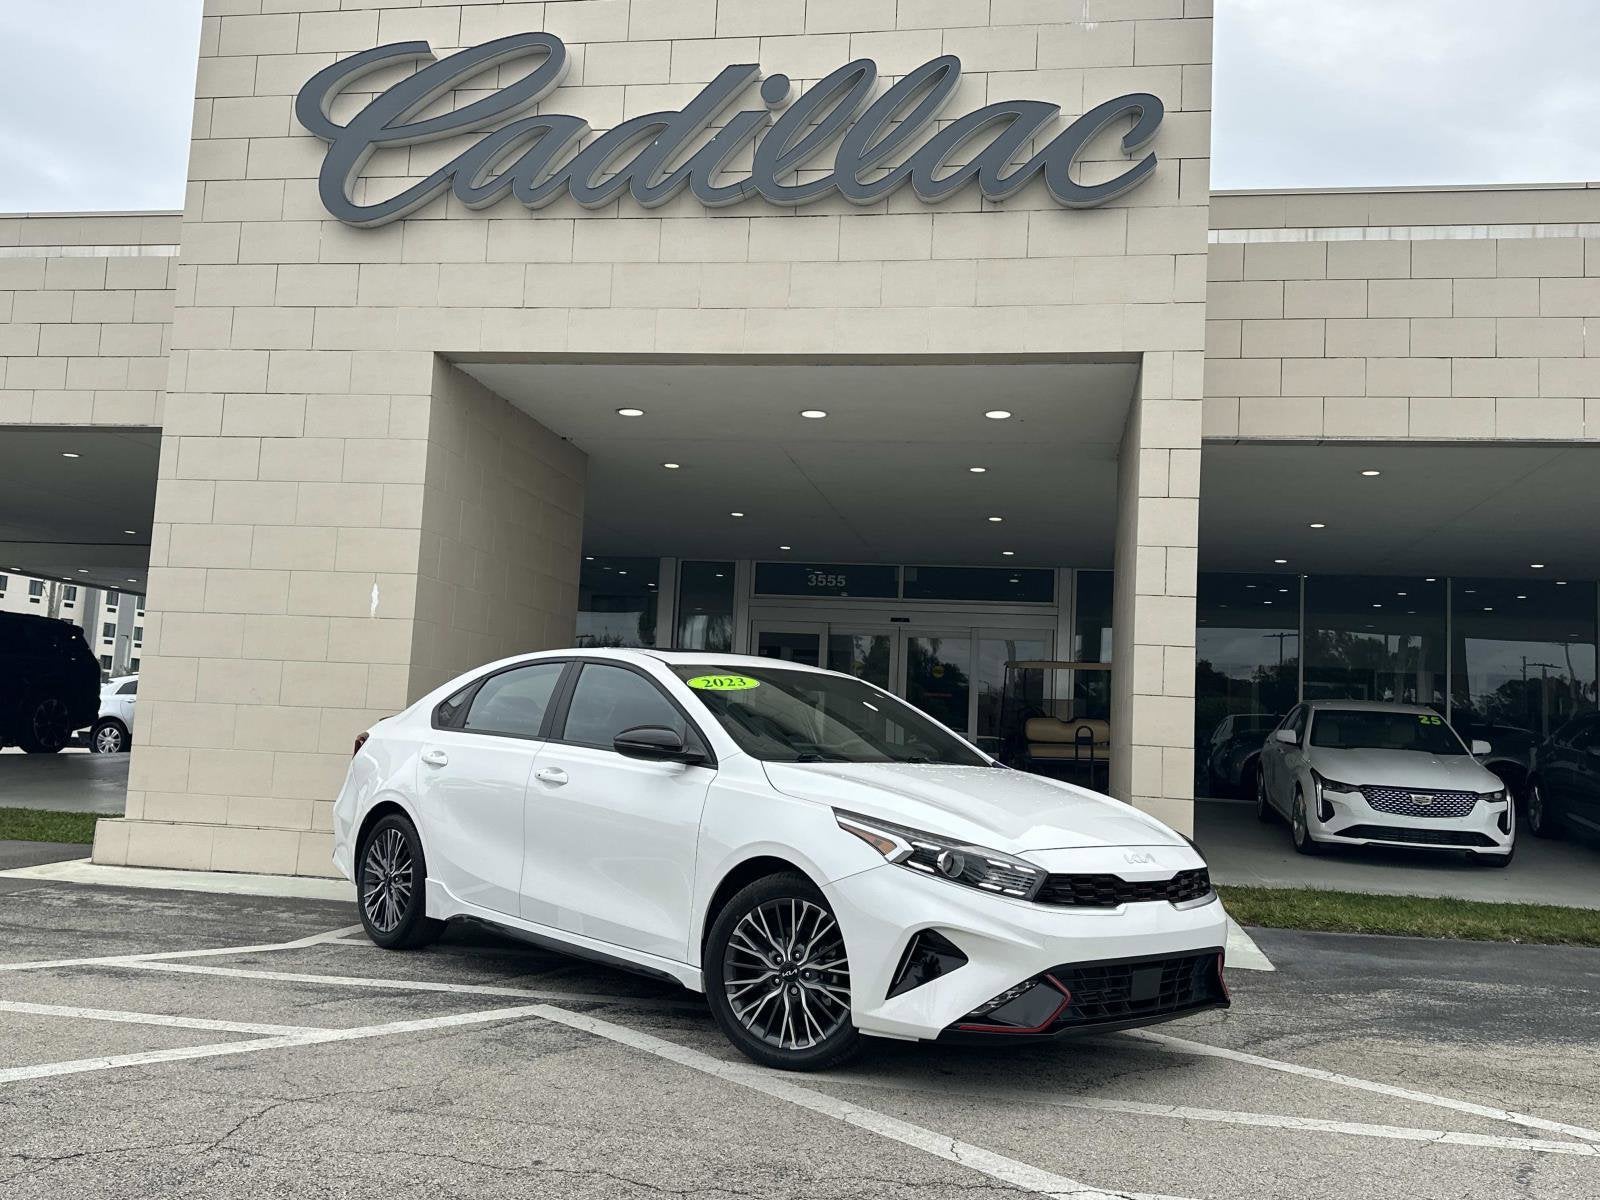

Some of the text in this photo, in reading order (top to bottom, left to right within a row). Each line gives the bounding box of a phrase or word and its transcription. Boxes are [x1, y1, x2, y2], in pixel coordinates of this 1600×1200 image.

[296, 32, 1165, 228] Cadillac
[807, 574, 846, 587] 3555
[701, 678, 746, 687] 2023
[1418, 715, 1441, 725] 25
